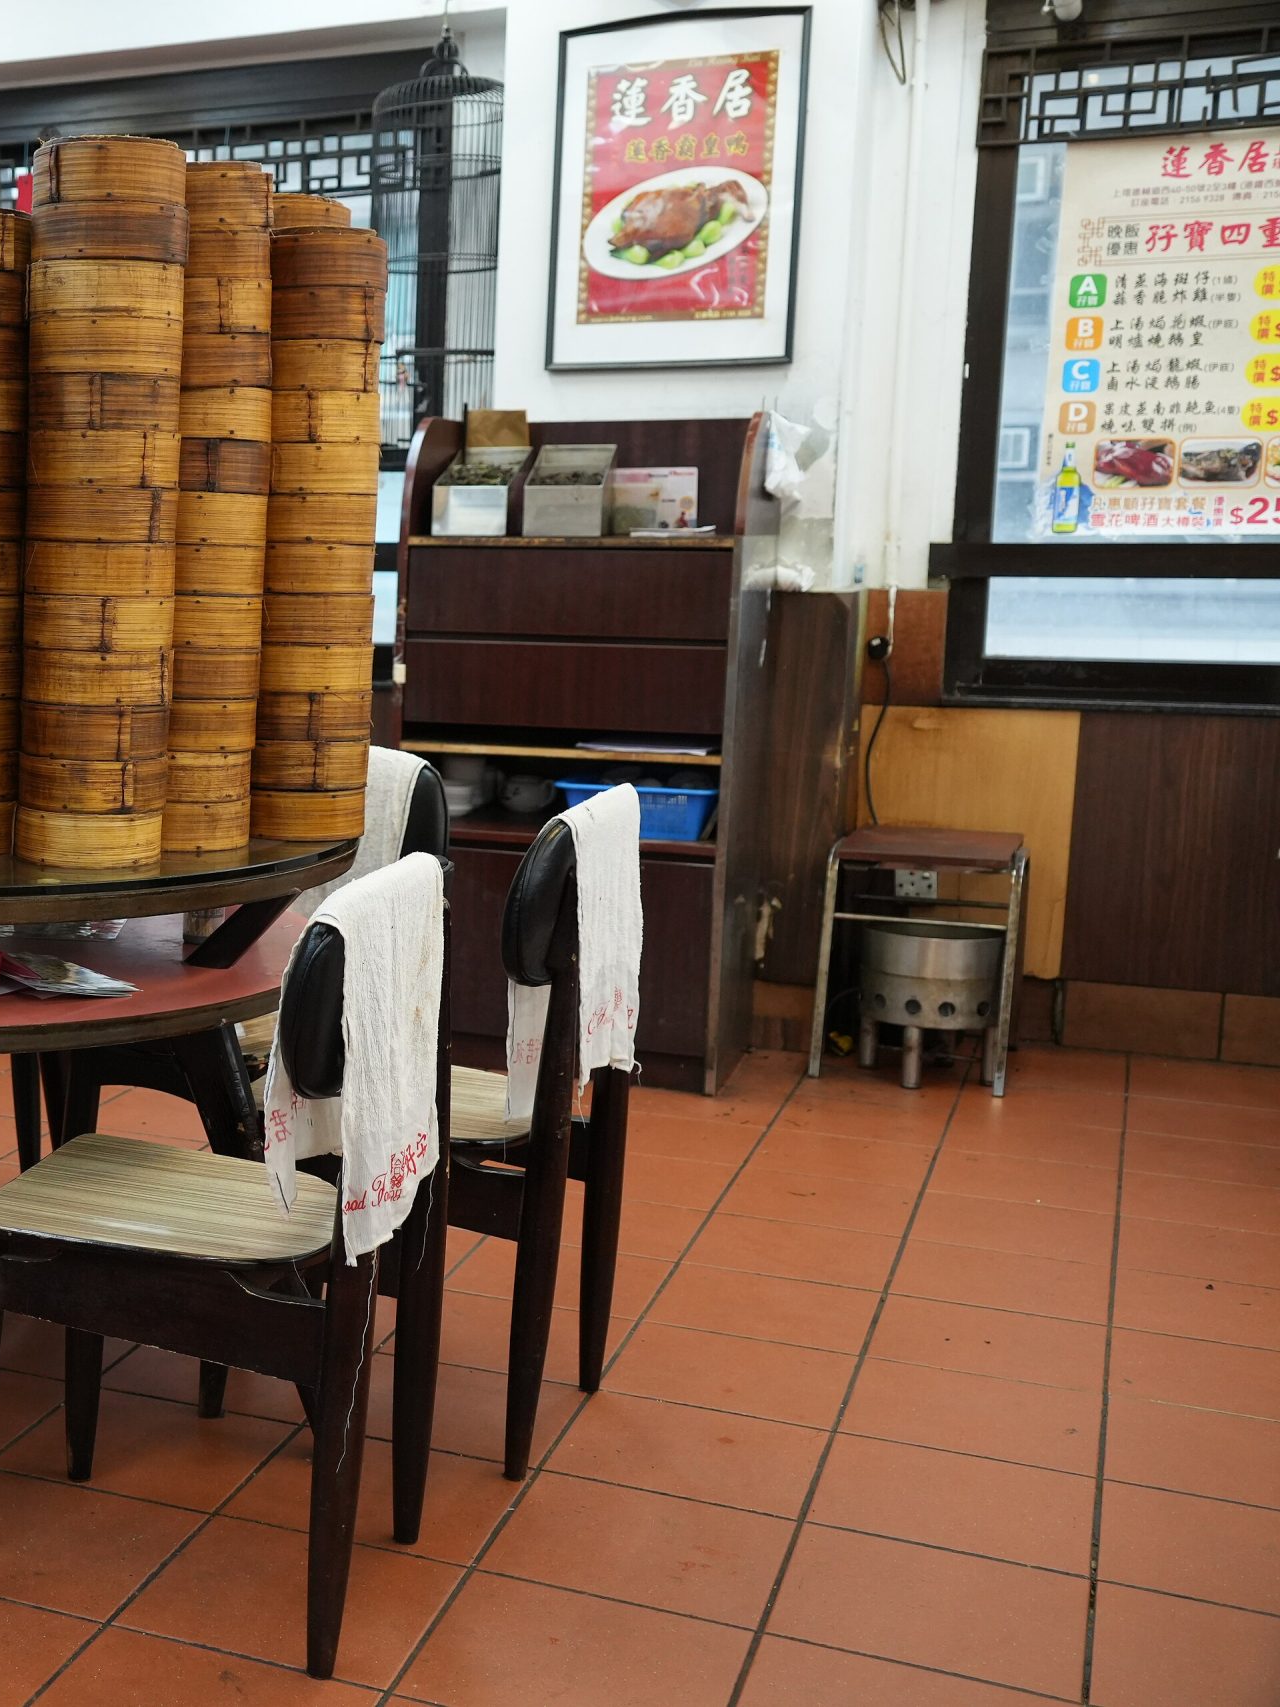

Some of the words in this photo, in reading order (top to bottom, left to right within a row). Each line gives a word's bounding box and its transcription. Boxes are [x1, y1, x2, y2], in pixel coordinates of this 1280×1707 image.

[611, 69, 755, 126] 蓮香居
[1161, 140, 1270, 178] 蓮香居
[1107, 223, 1140, 239] 晚飯
[1077, 276, 1098, 295] A
[1078, 319, 1094, 337] B
[1072, 361, 1091, 380] C
[1070, 403, 1088, 421] D
